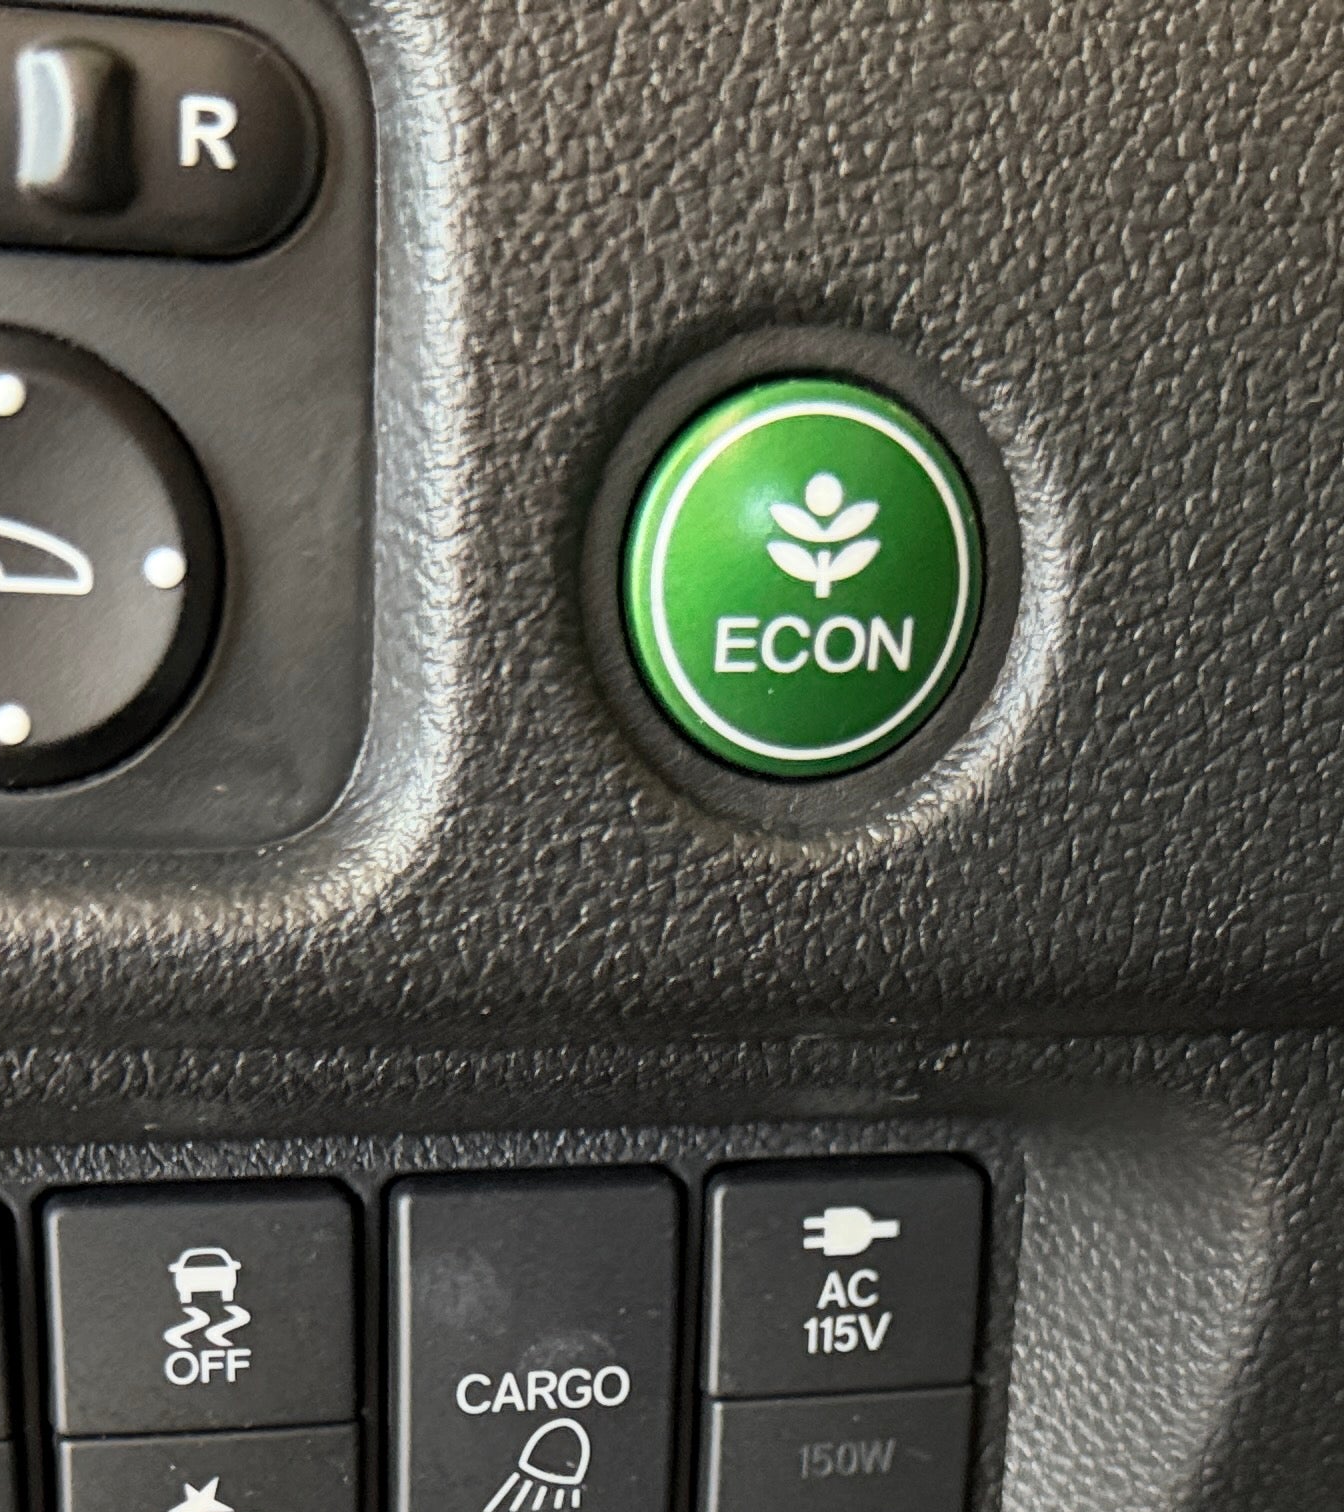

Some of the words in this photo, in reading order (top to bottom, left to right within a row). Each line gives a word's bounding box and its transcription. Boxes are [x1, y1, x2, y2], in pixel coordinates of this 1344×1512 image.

[178, 94, 238, 170] R
[714, 615, 914, 673] ECON
[816, 1269, 879, 1310] AC
[804, 1311, 892, 1354] 115V
[164, 1348, 251, 1386] OFF
[456, 1365, 630, 1415] CARGO
[799, 1439, 897, 1479] 150W
